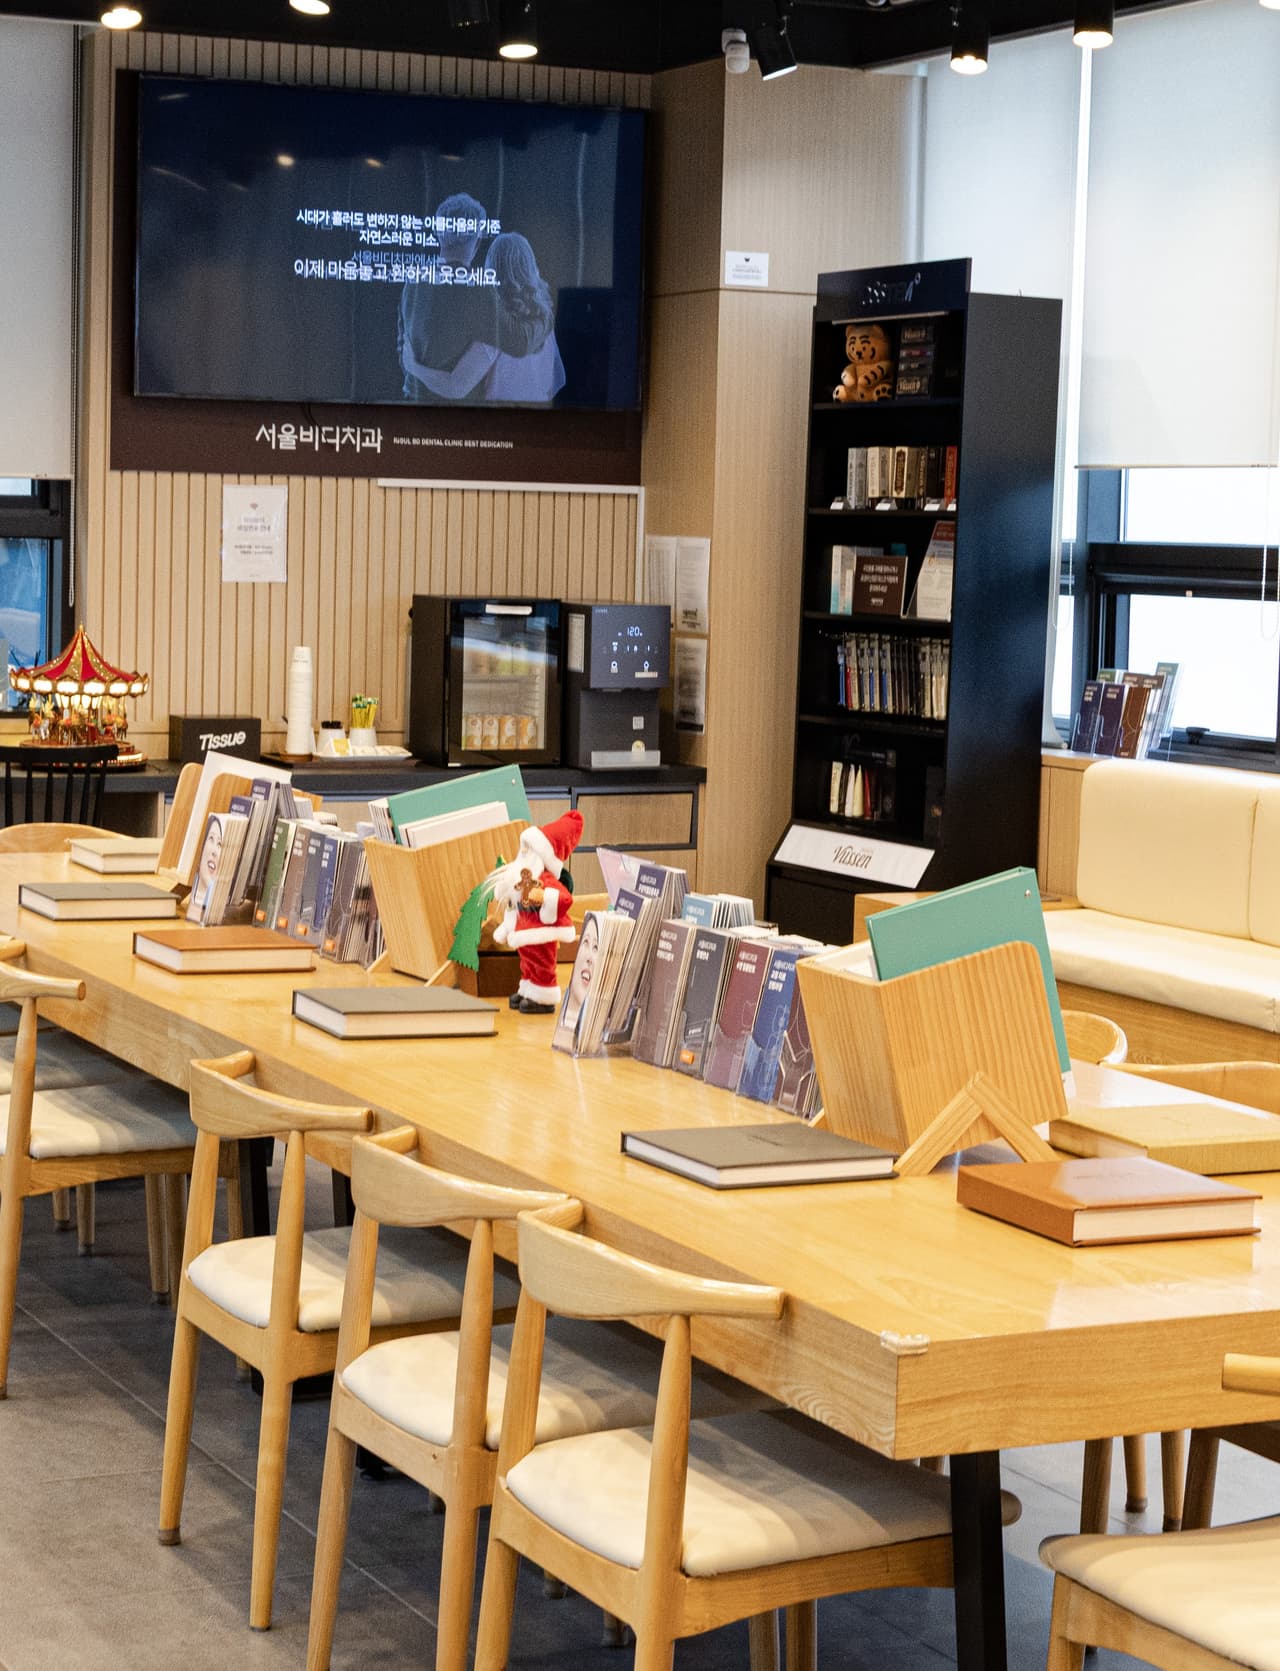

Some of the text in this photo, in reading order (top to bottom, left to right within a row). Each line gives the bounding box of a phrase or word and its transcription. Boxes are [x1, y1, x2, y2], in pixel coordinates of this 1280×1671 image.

[296, 209, 330, 226] 시대가
[479, 219, 501, 235] 기준
[359, 230, 413, 246] 자연스러운
[294, 258, 324, 279] 이제
[328, 259, 388, 281] 마음놓고
[255, 423, 383, 454] 서울비디치과
